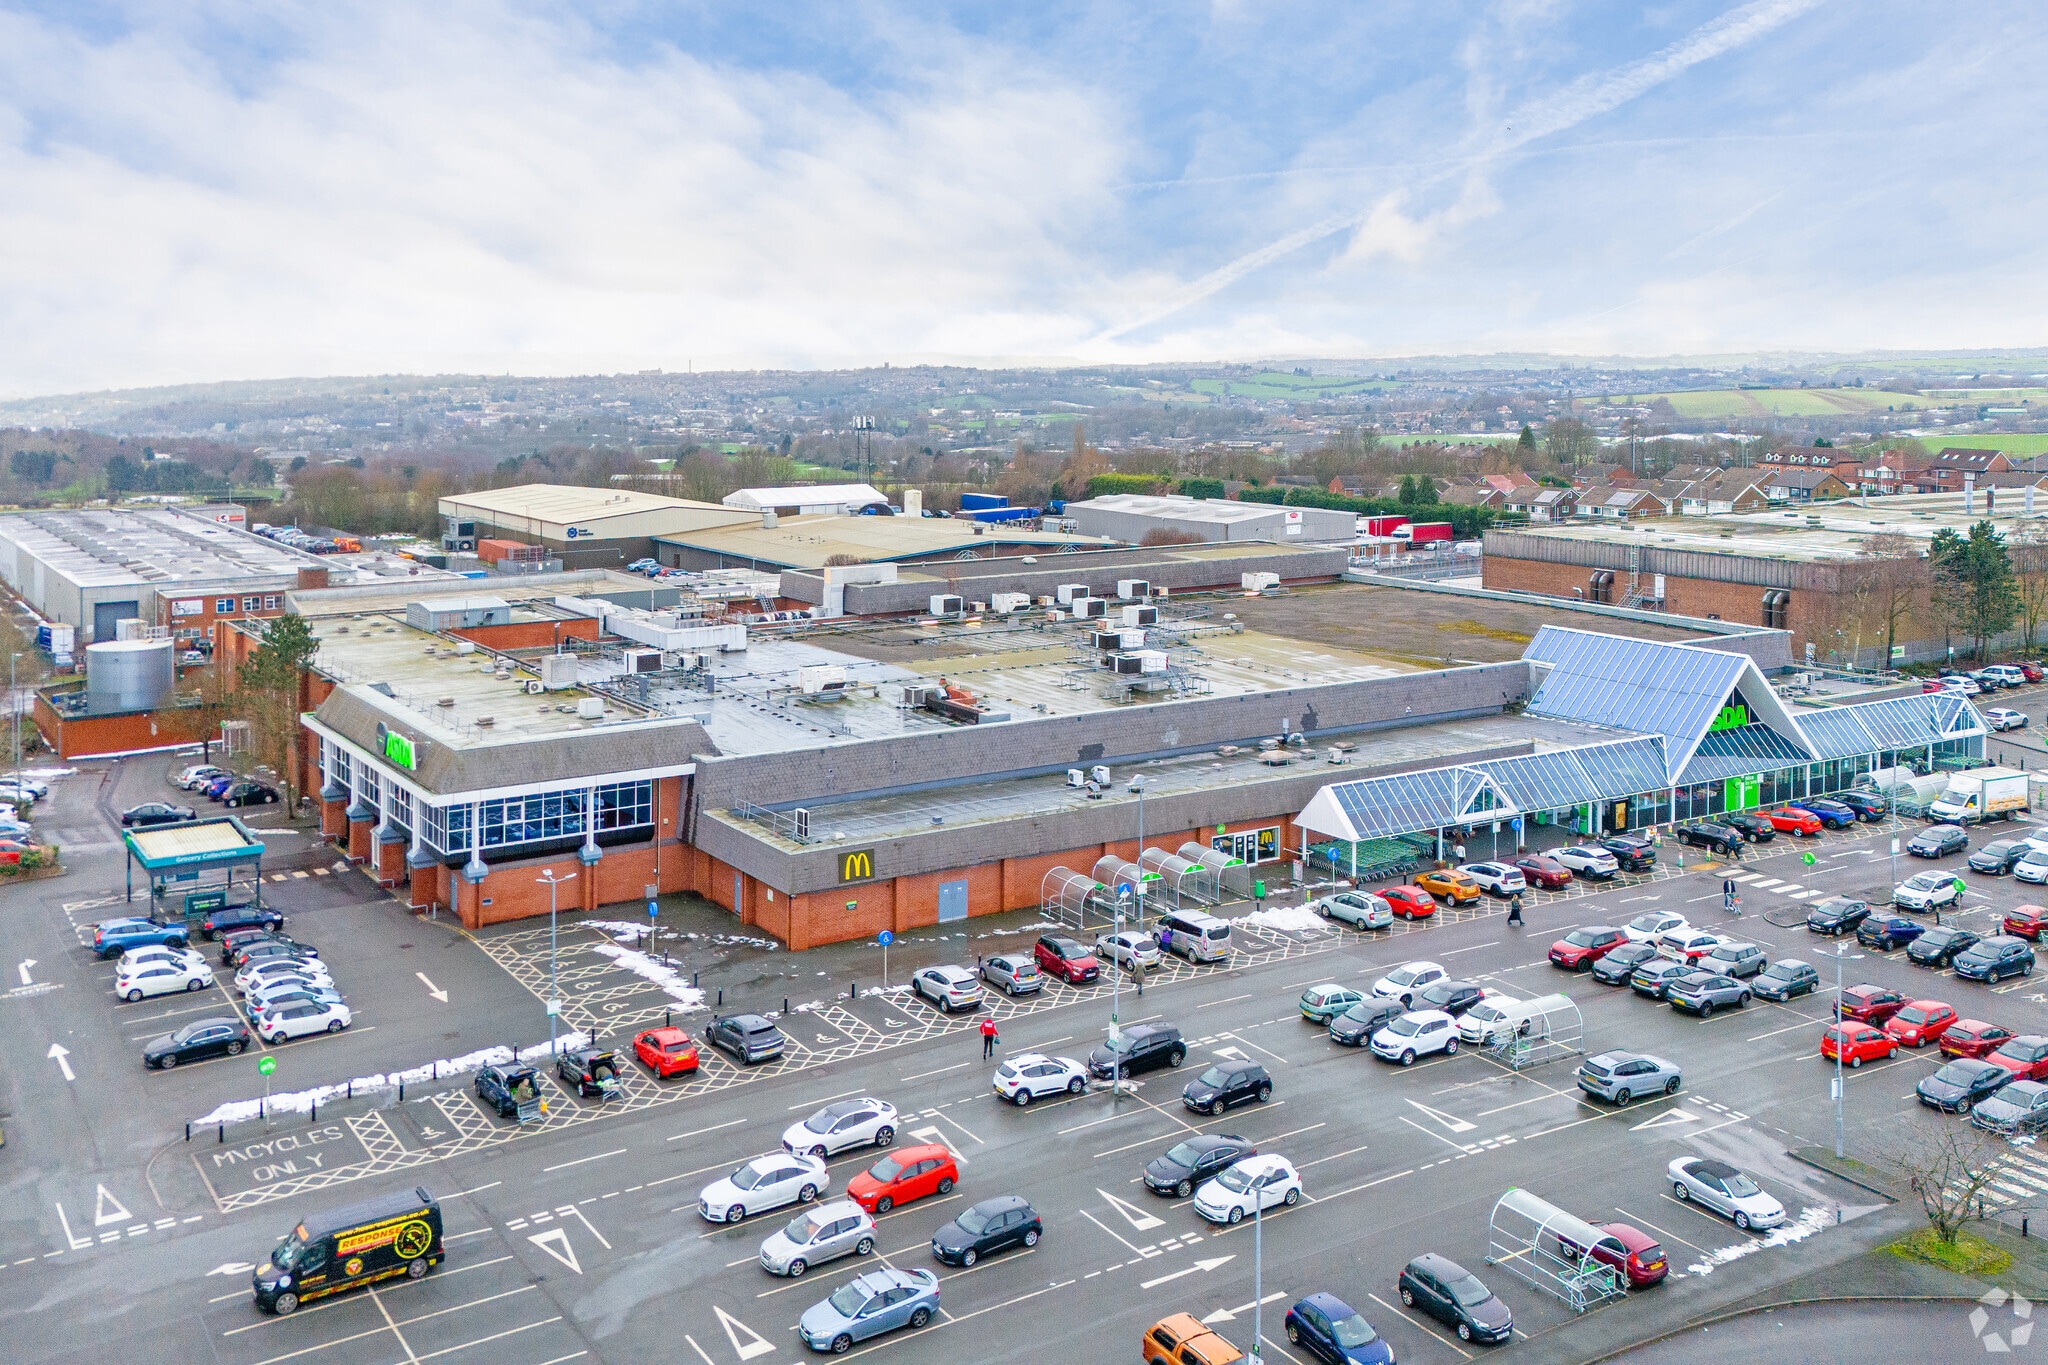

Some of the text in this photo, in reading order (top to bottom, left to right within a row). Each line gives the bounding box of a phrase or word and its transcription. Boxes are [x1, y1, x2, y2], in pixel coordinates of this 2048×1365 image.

[1709, 705, 1748, 732] SDA
[175, 850, 237, 863] Grocery Collections
[252, 1153, 322, 1181] ONLY
[342, 1227, 402, 1248] RESPONSE
